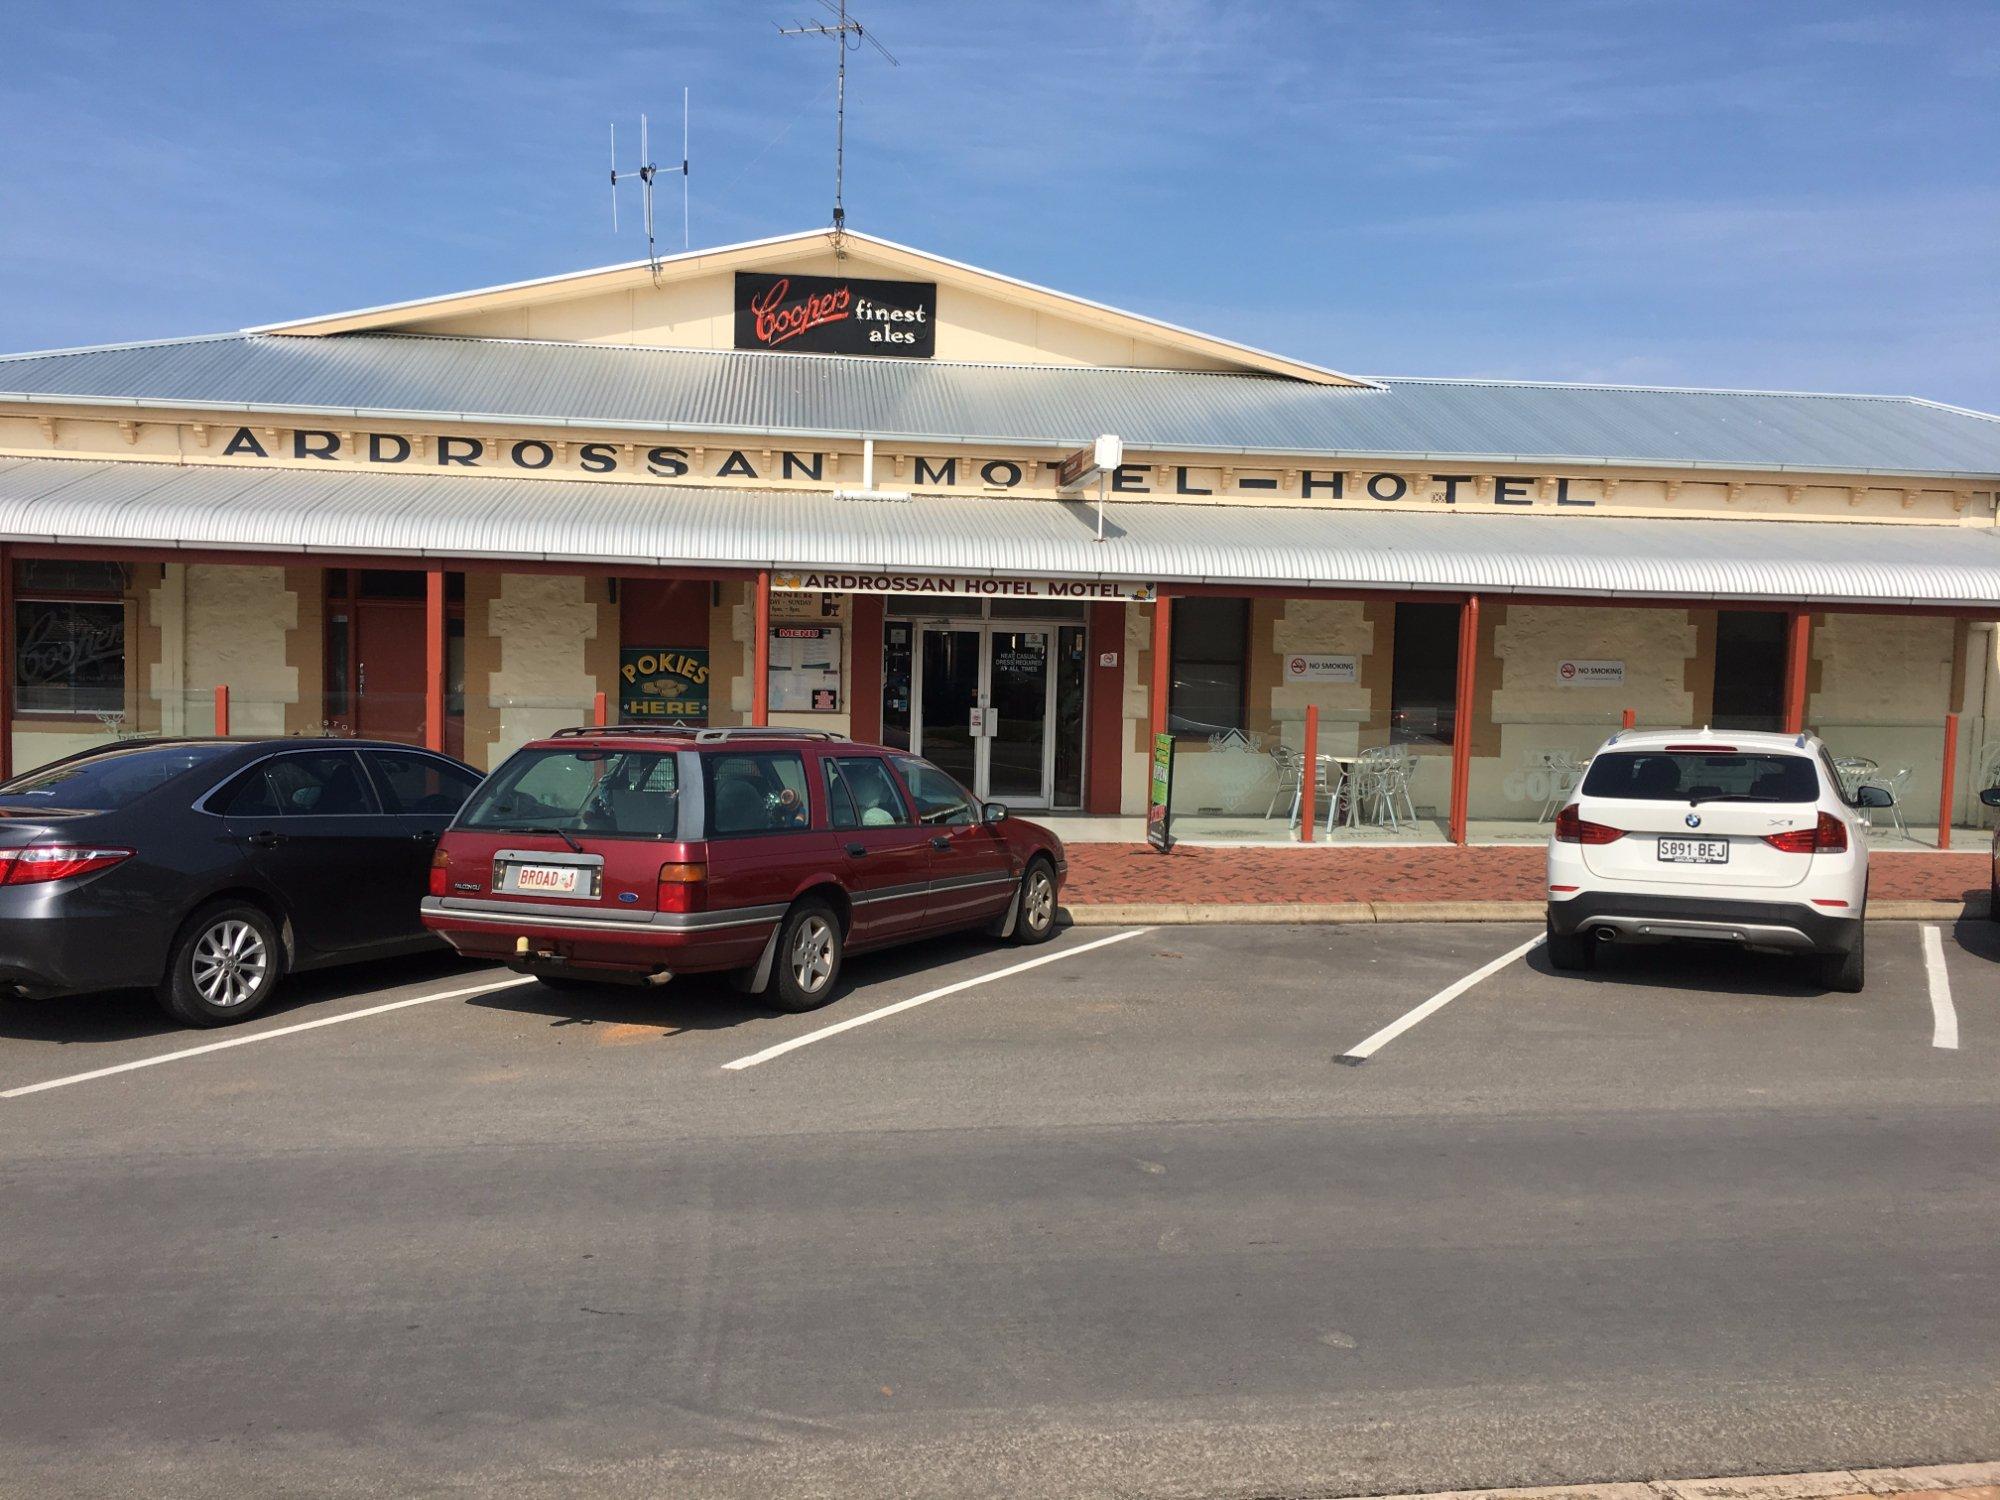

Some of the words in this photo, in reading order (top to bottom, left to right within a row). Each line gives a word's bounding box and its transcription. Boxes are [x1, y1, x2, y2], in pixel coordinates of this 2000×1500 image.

[751, 278, 850, 343] Coopers
[855, 299, 926, 323] finest
[869, 324, 915, 344] ales
[221, 426, 823, 481] ARDROSSAN
[804, 574, 955, 593] ARDROSSAN
[964, 579, 1039, 596] HOTEL
[1048, 582, 1126, 598] MOTEL
[779, 628, 819, 638] MENU
[621, 653, 709, 684] POKIES
[1309, 662, 1320, 670] NO
[1321, 662, 1354, 670] SMOKING
[630, 701, 700, 714] HERE
[520, 869, 559, 887] BROAD
